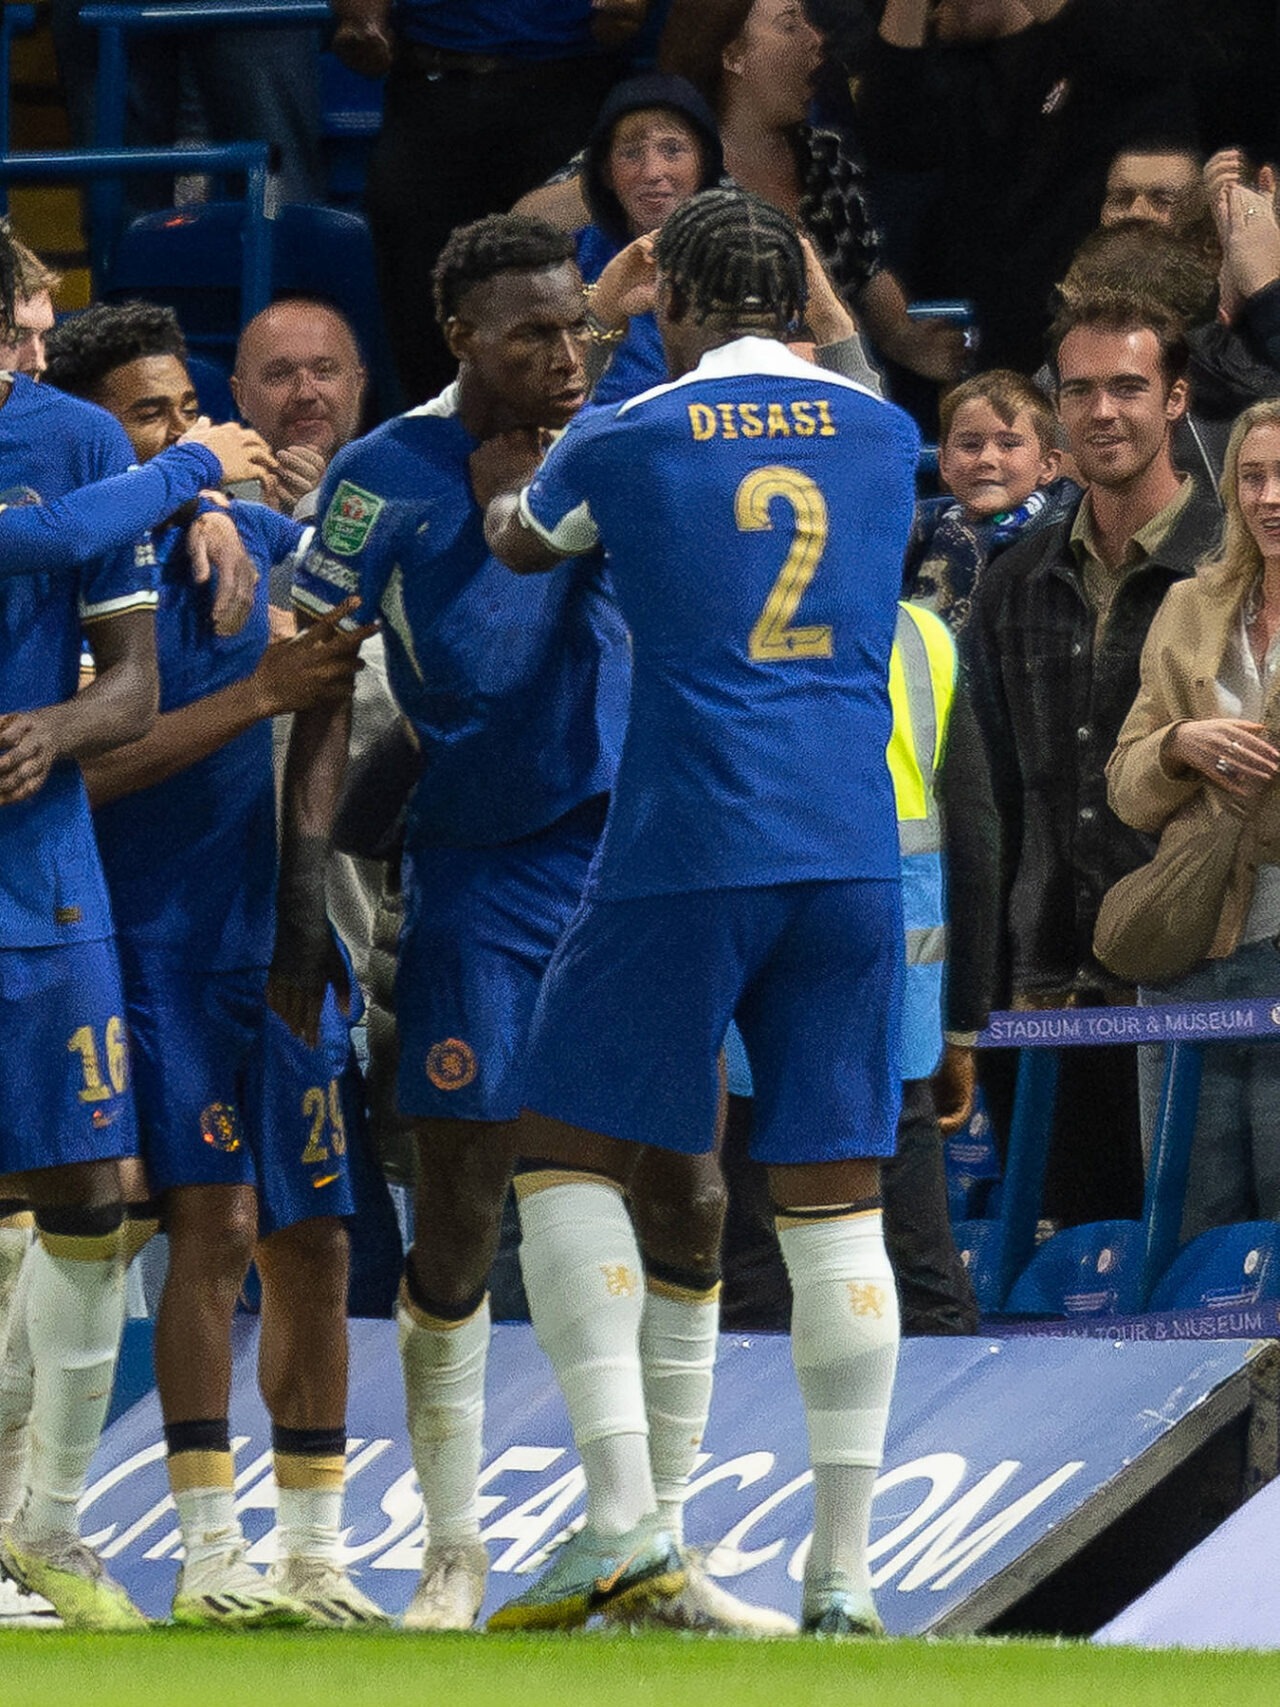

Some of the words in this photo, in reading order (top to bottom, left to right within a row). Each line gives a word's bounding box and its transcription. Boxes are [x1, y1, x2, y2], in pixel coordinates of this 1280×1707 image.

[687, 400, 837, 441] DISASI
[733, 465, 835, 664] 2
[989, 1018, 1081, 1040] STADIUM
[1086, 1016, 1141, 1036] TOUR
[1145, 1017, 1160, 1034] &
[1165, 1009, 1255, 1032] MUSEUM
[66, 1015, 129, 1103] 16
[1172, 1313, 1264, 1337] MUSEUM
